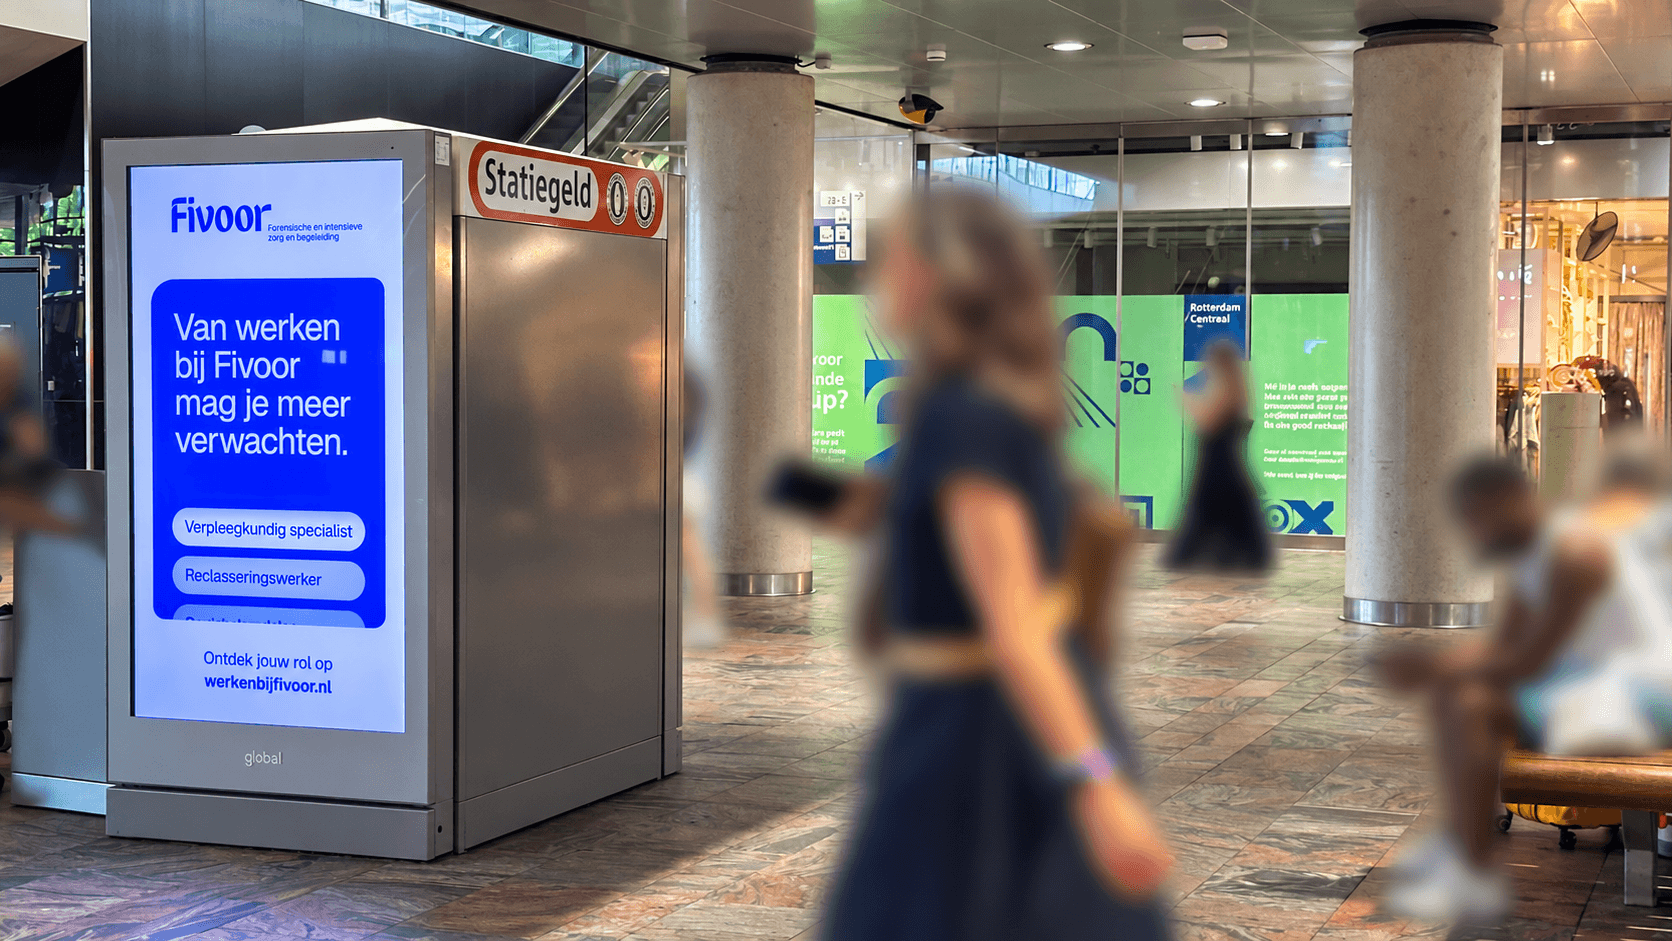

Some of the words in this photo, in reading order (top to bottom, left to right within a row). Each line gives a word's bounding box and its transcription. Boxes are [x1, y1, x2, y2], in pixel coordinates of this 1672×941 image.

[485, 158, 591, 213] Statiegeld
[171, 197, 272, 233] Fivoor
[267, 223, 312, 232] Forensische
[324, 222, 363, 231] intensieve
[267, 234, 284, 243] zorg
[285, 234, 295, 242] en
[1190, 302, 1241, 312] Rotterdam
[173, 312, 227, 341] Van
[235, 312, 340, 341] werken
[1190, 313, 1231, 324] Centraal
[175, 350, 205, 384] bij
[214, 350, 301, 379] Fivoor
[175, 394, 236, 423] mag
[243, 388, 269, 422] je
[277, 394, 351, 418] meer
[175, 426, 348, 456] verwachten.
[184, 519, 287, 539] Verpleegkundig
[289, 523, 353, 540] specialist
[185, 567, 322, 587] Reclasseringswerker
[203, 650, 253, 667] Ontdek
[255, 653, 290, 670] jouw
[293, 655, 312, 670] rol
[315, 658, 333, 673] op
[204, 674, 333, 694] werkenbijfivoor.nl
[244, 750, 283, 767] global
